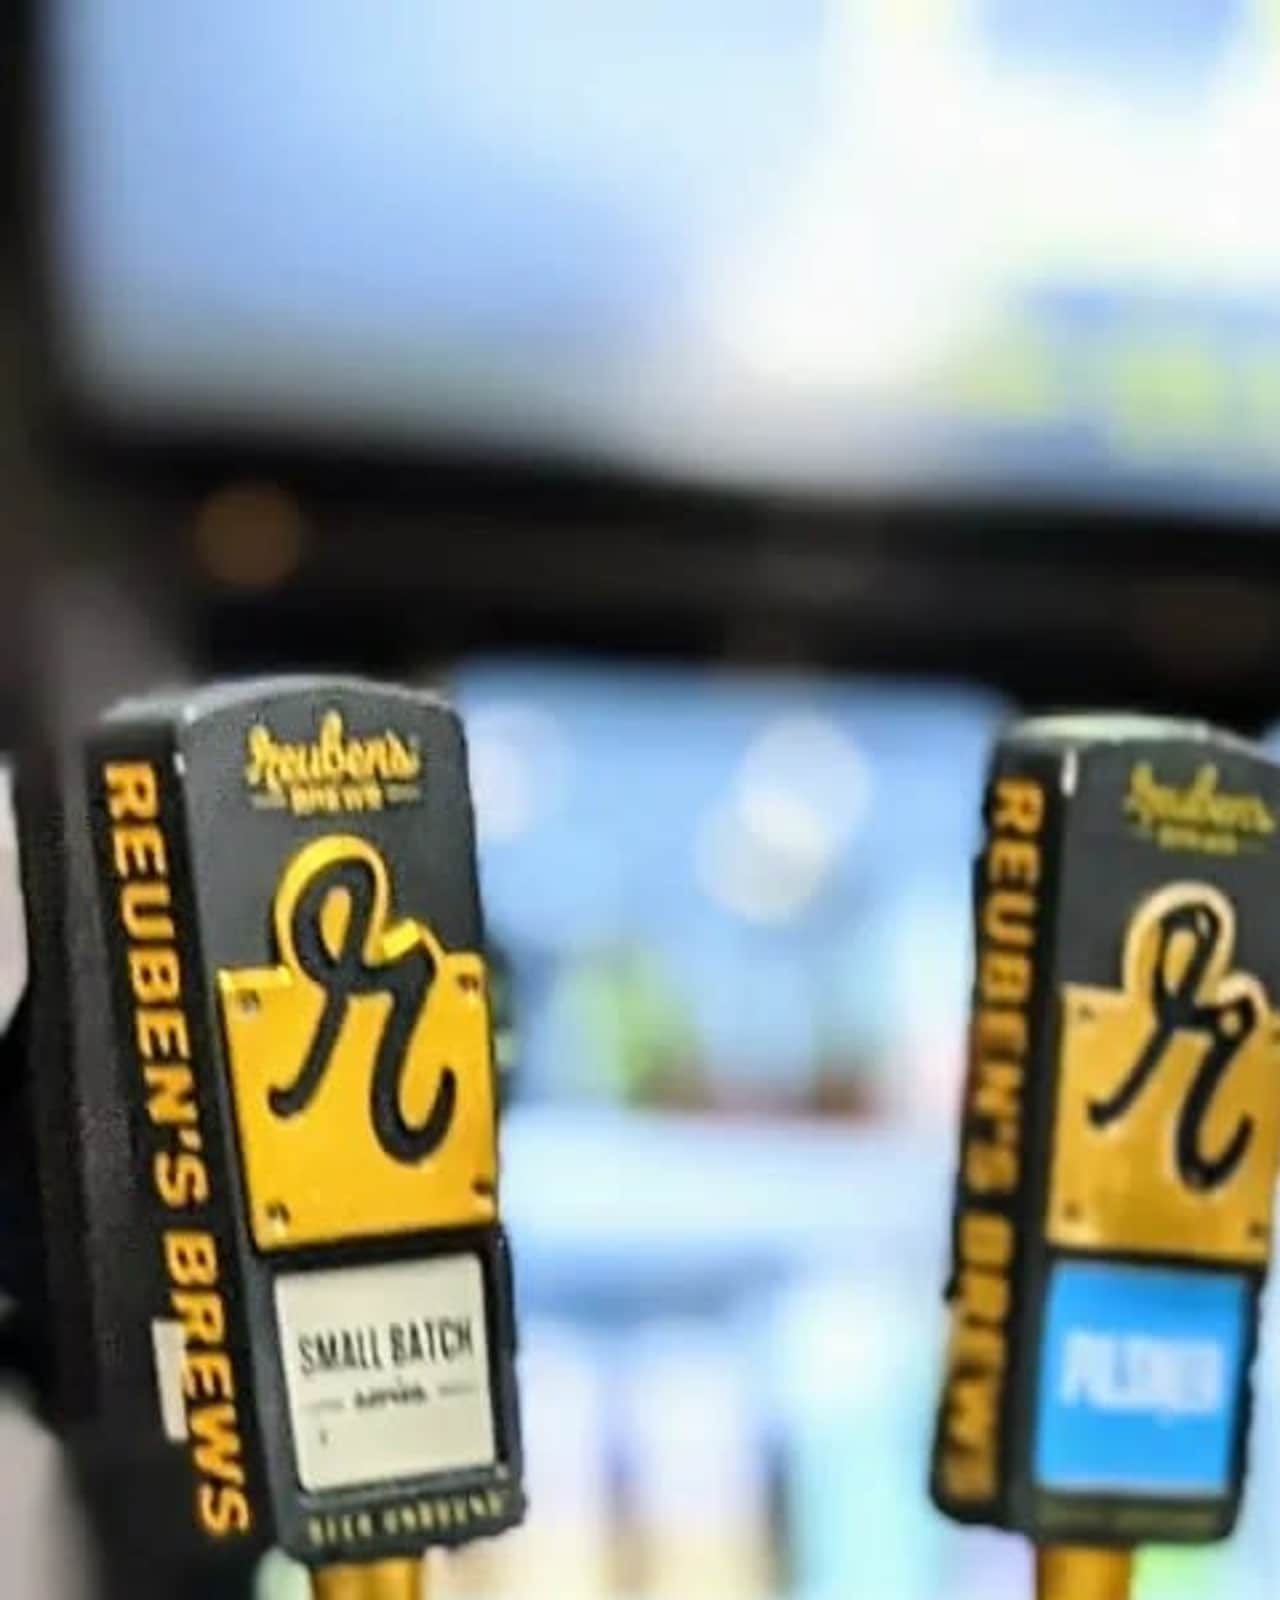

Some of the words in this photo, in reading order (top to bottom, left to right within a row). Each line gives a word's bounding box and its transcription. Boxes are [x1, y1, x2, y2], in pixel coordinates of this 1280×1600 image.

[104, 760, 207, 1206] REUBEN'S
[161, 1229, 249, 1538] BREWS
[299, 1325, 383, 1378] SMALL
[390, 1317, 474, 1368] BATCH
